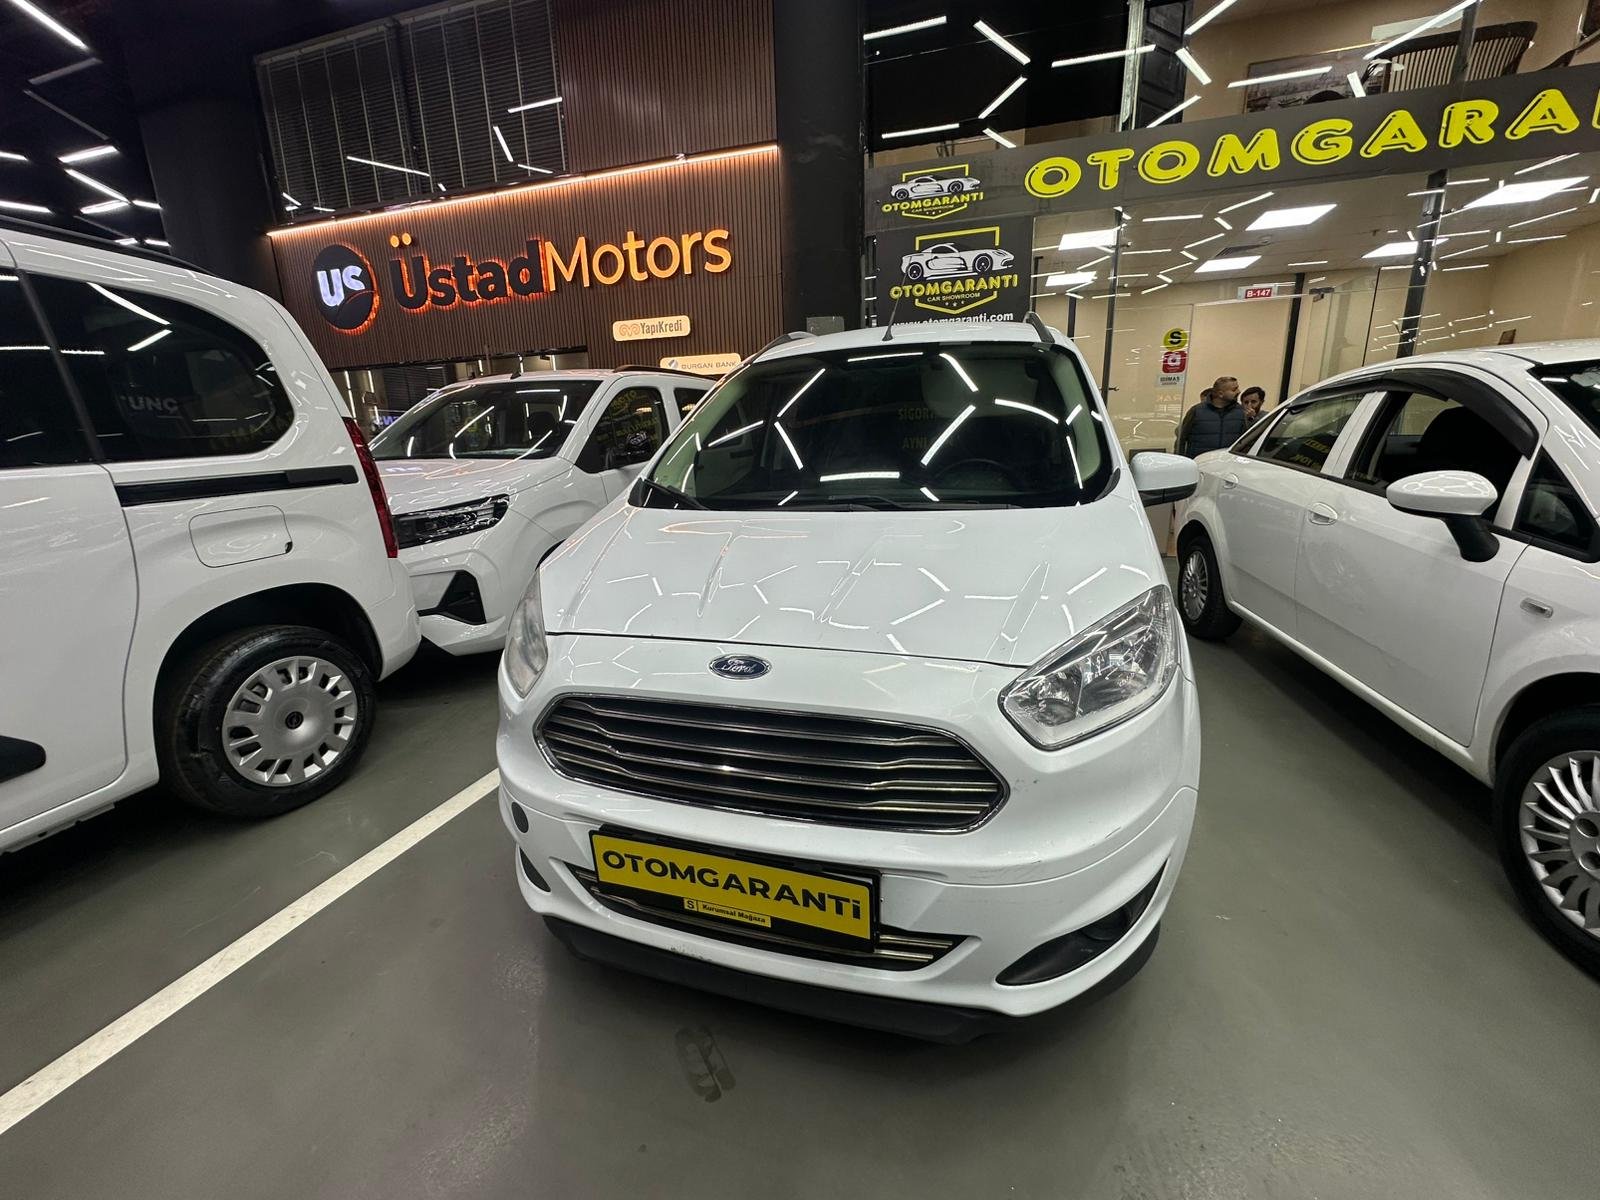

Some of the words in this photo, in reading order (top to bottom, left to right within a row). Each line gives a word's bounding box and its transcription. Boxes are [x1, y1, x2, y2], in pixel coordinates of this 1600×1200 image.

[1024, 88, 1600, 198] OTOMGARA
[882, 191, 984, 212] OTOMGARANTI
[889, 274, 1018, 299] OTOMGARANTI
[1246, 288, 1271, 298] B-147
[942, 292, 981, 300] SHOWROOM
[893, 312, 1014, 326] otomgaranti.com
[1169, 331, 1182, 345] S
[722, 659, 757, 673] Ford
[687, 900, 695, 910] S
[702, 904, 736, 917] Kurumsal
